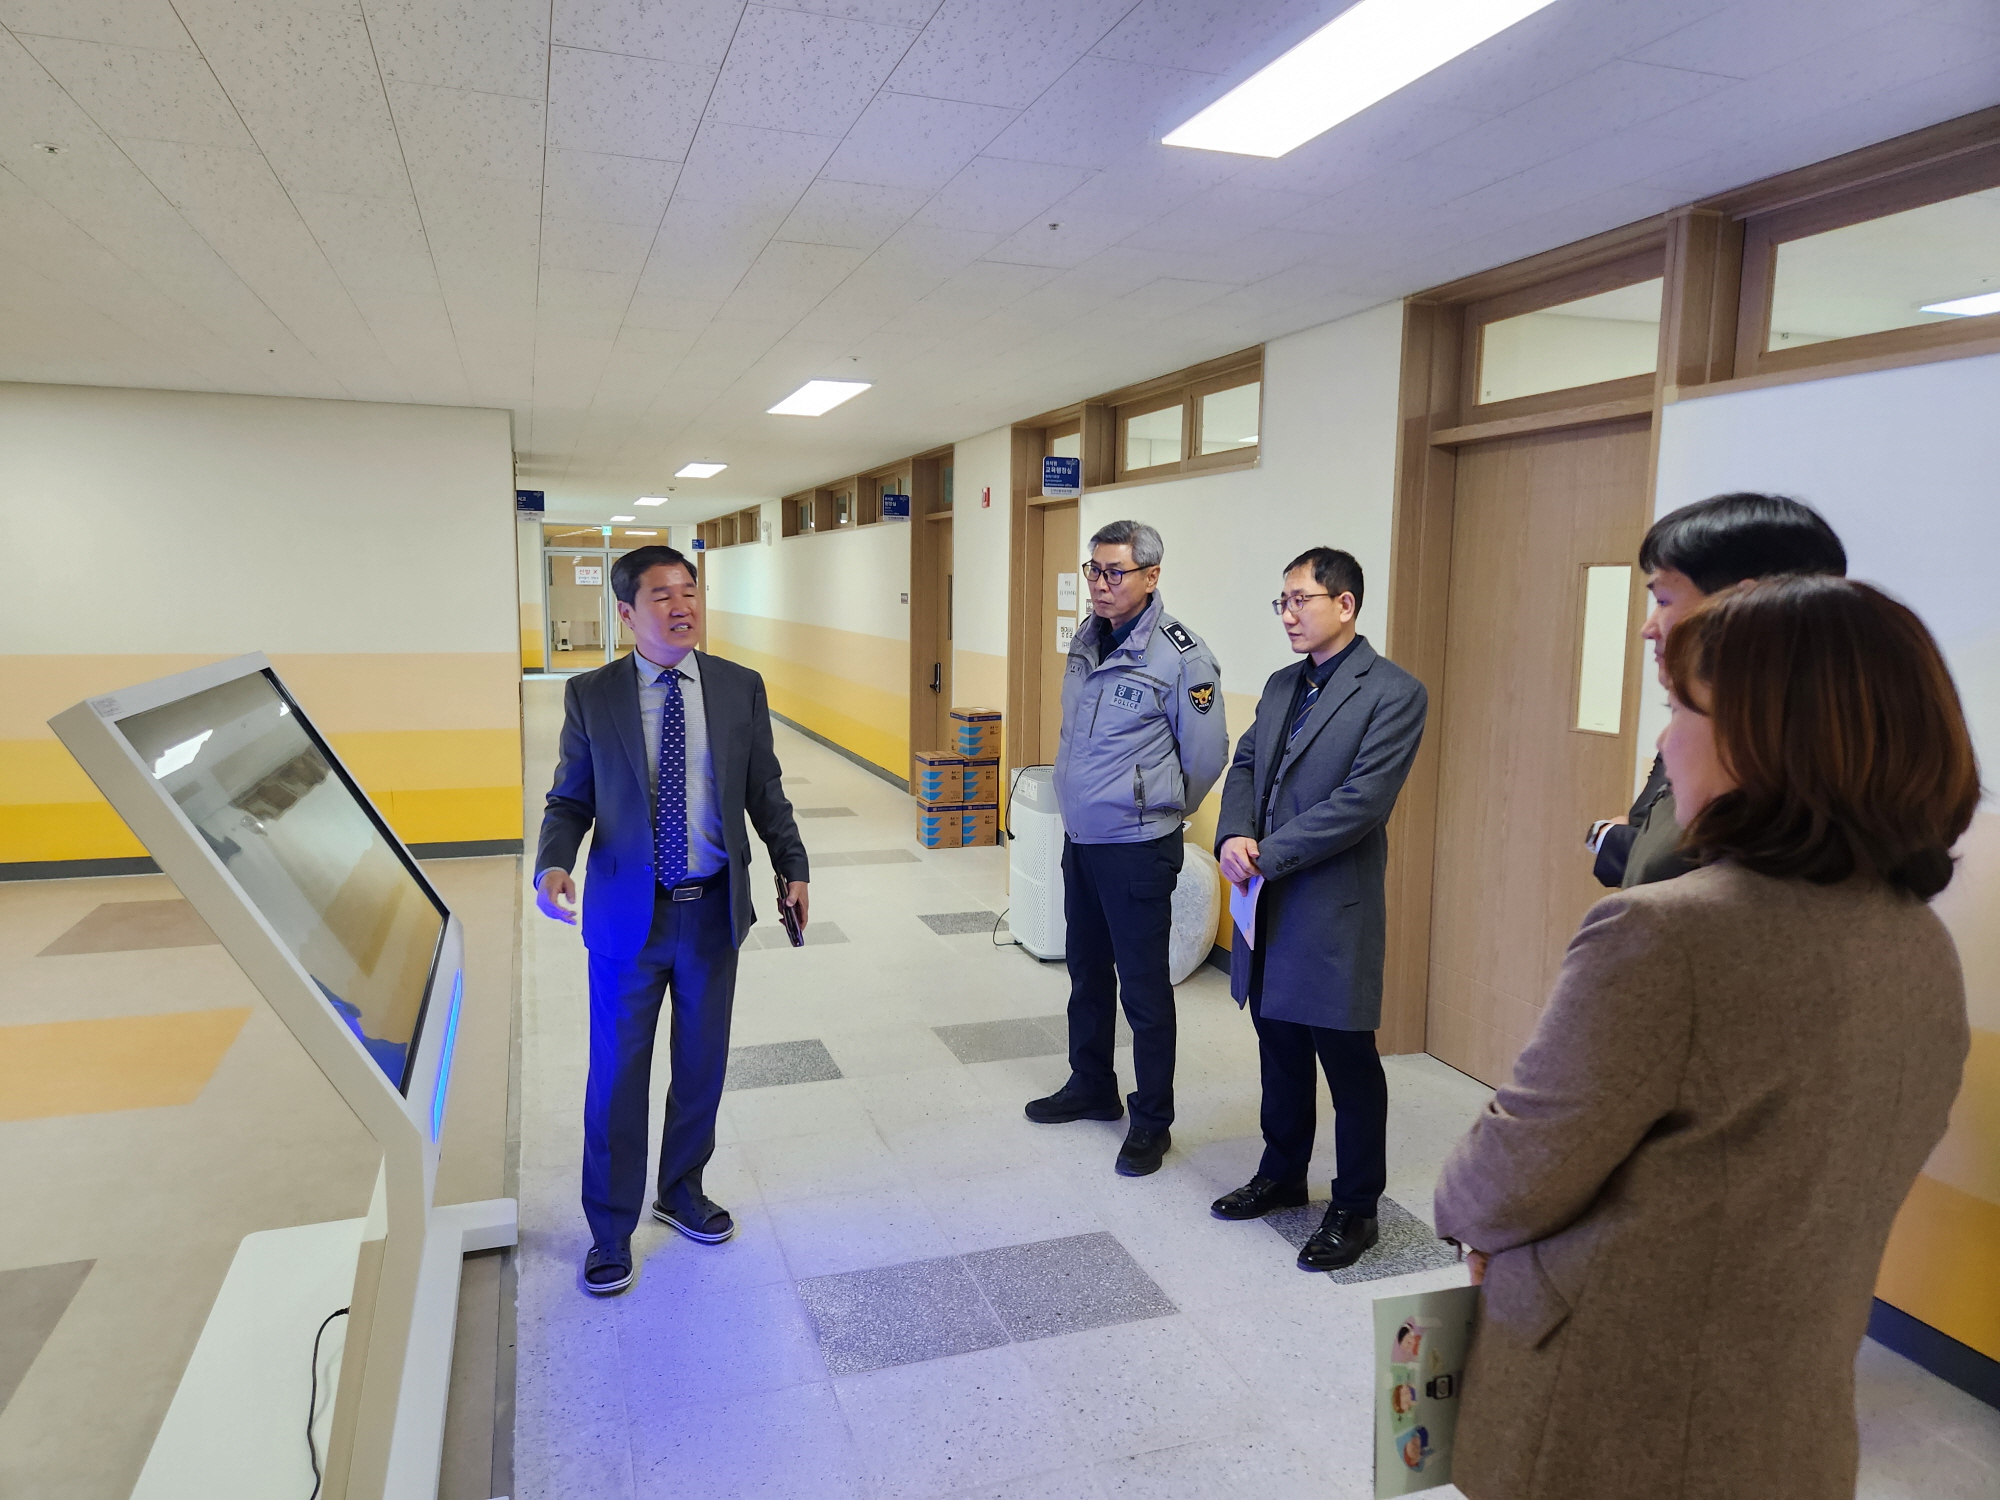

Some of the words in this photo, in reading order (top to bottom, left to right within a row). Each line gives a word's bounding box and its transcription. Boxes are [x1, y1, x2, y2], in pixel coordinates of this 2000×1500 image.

[1045, 466, 1072, 474] 교육행정실
[1118, 685, 1141, 702] 경찰
[1113, 697, 1138, 709] POLICE
